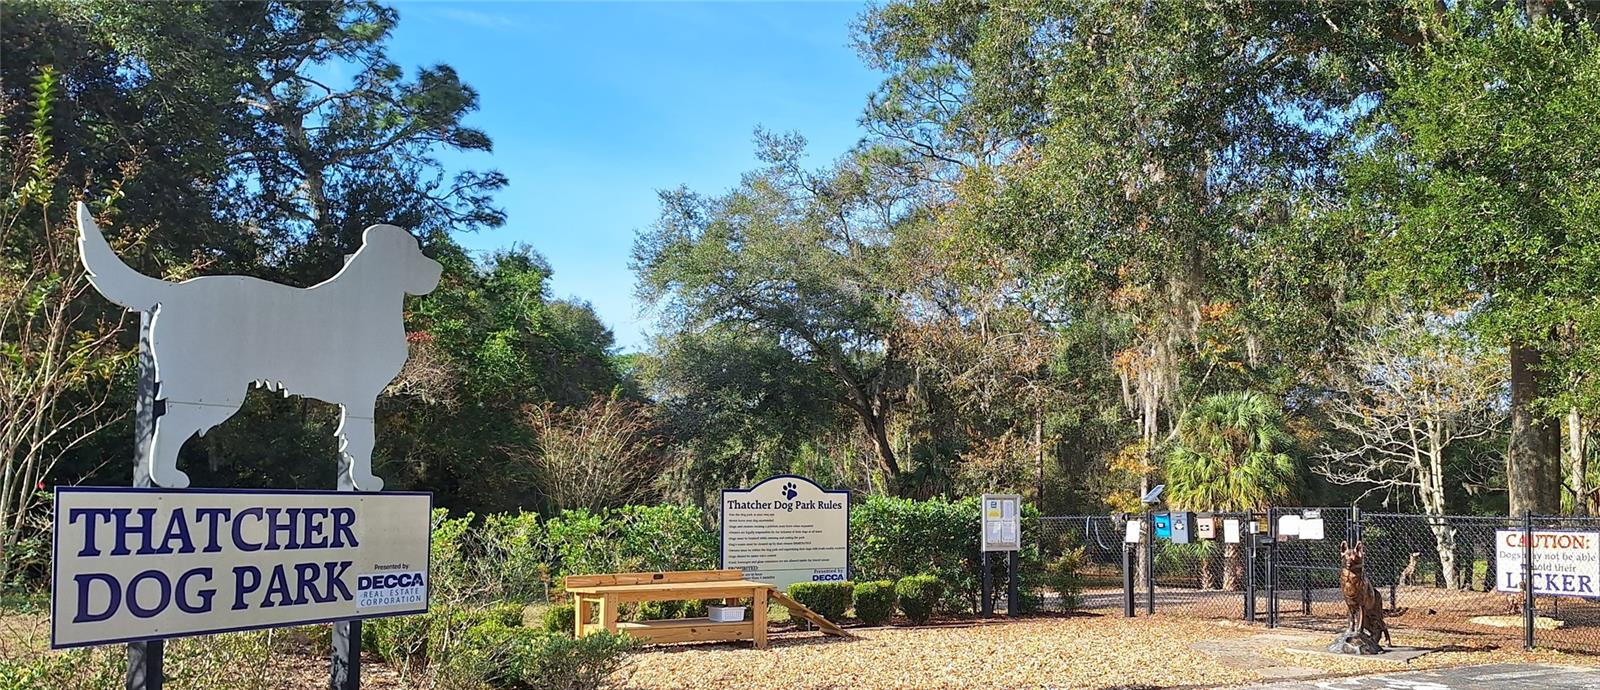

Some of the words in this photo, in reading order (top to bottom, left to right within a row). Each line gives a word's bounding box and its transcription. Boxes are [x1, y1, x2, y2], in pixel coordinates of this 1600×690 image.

[727, 499, 772, 510] Thatcher
[774, 499, 793, 513] Dog
[795, 499, 816, 510] Park
[818, 500, 843, 510] Rules
[69, 507, 359, 557] THATCHER
[1499, 550, 1521, 561] Dogs
[1544, 552, 1560, 561] not
[1562, 551, 1574, 561] be
[1576, 552, 1597, 562] able
[1554, 563, 1577, 573] their
[358, 573, 424, 591] DECCA
[812, 574, 844, 582] DECCA
[72, 567, 217, 624] DOG
[231, 560, 354, 611] PARK
[363, 590, 384, 598] REAL
[389, 587, 419, 596] ESTATE
[360, 595, 421, 607] CORPORATION
